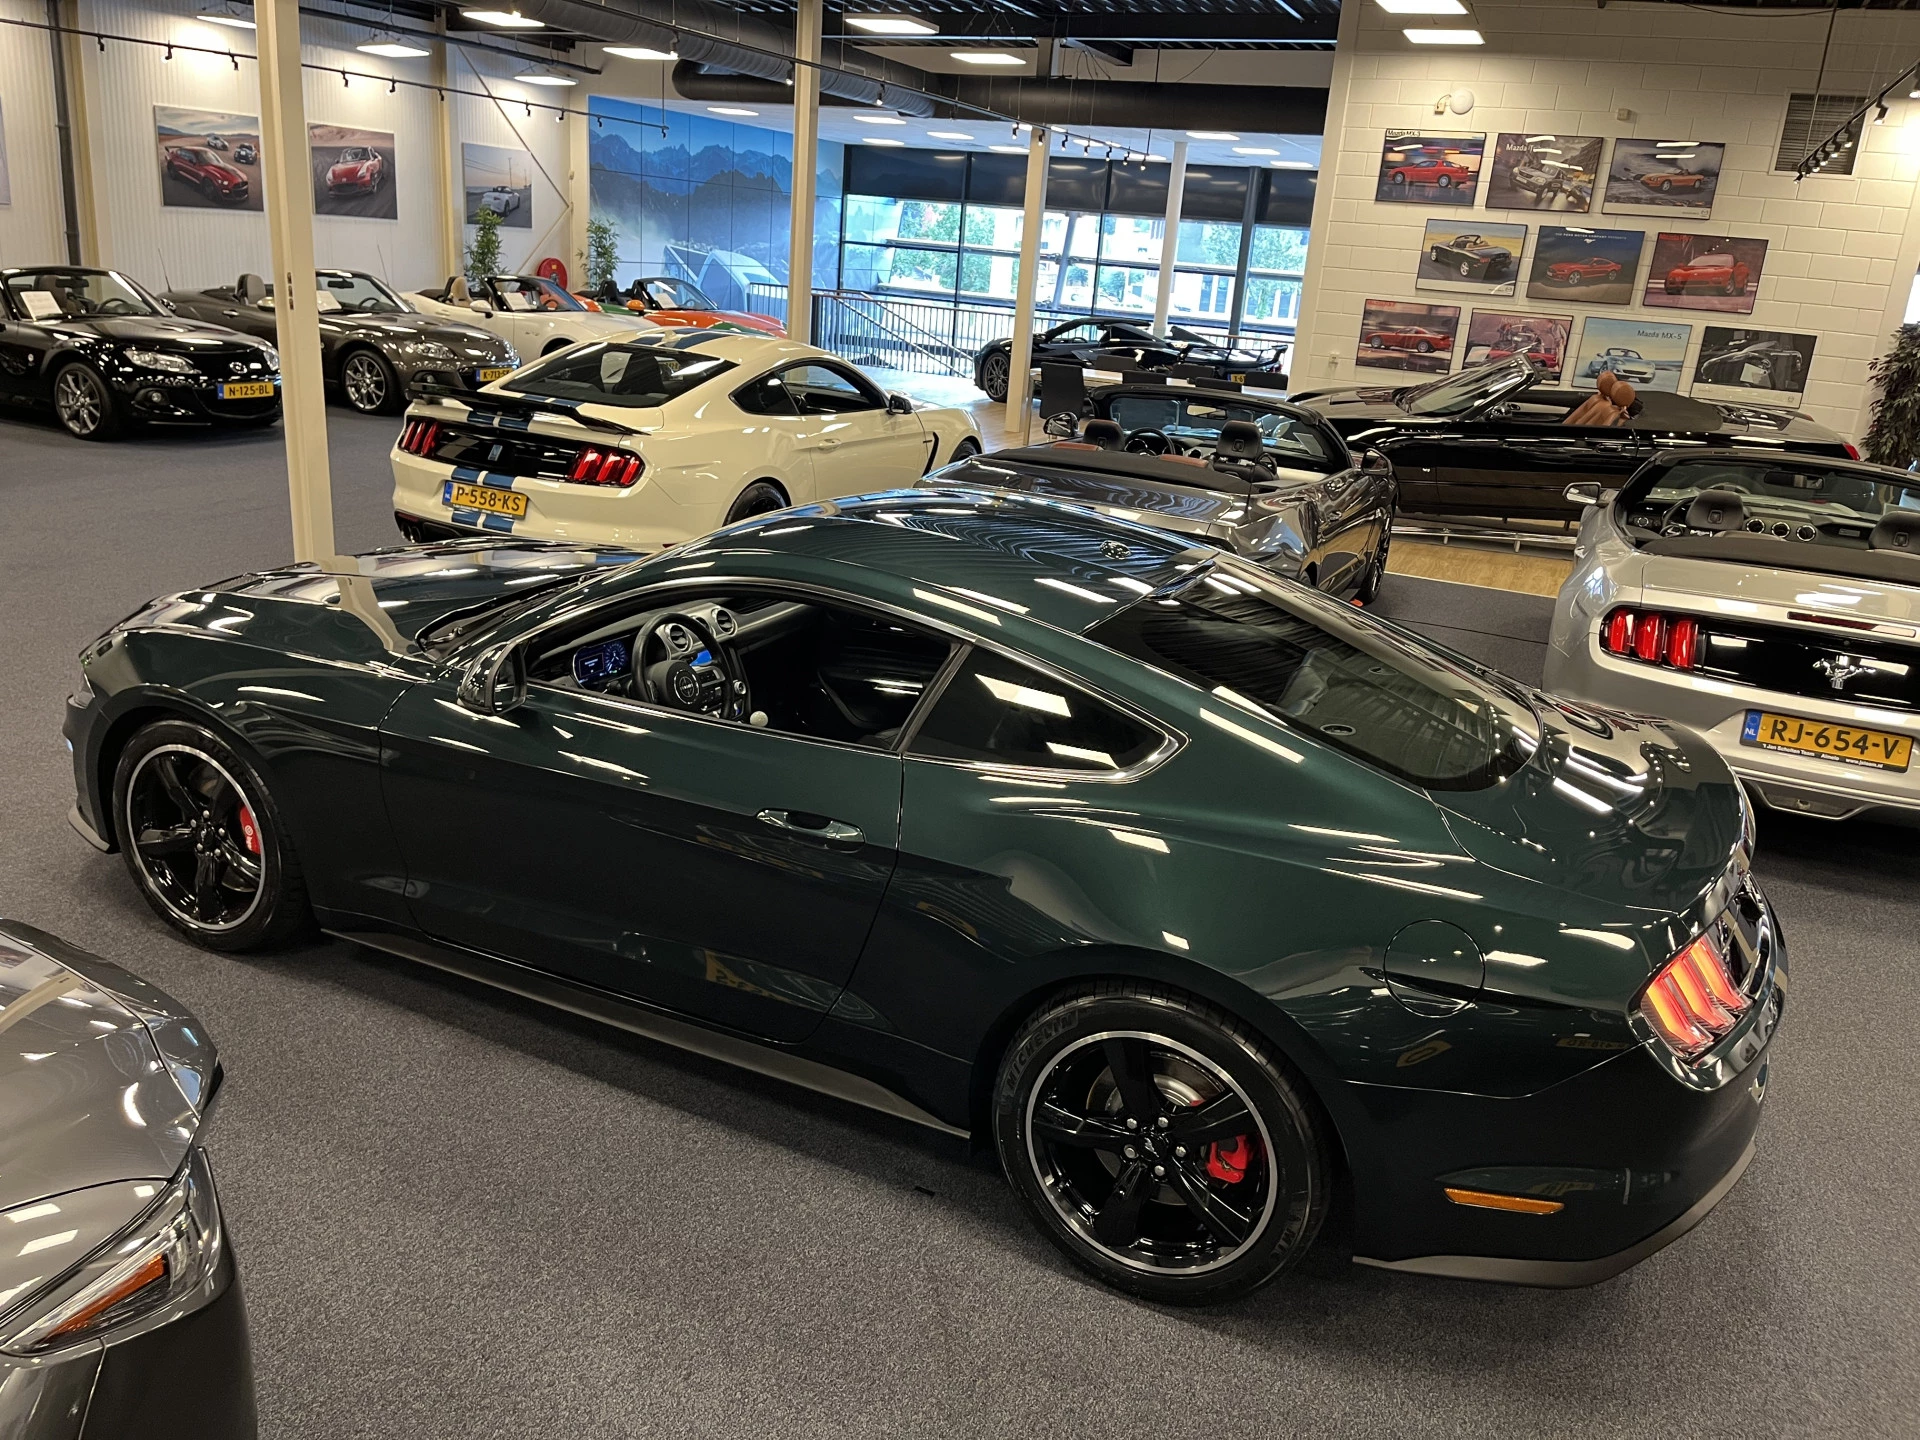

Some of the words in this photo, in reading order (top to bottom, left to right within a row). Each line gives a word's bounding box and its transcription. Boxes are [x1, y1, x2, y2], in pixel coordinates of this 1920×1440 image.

[1505, 143, 1528, 152] Mazda
[1637, 330, 1660, 338] Mazda
[1661, 331, 1683, 340] MX-5
[228, 384, 271, 397] N-125-BL
[455, 486, 522, 512] P-558-KS
[1744, 727, 1757, 736] NL
[1769, 719, 1900, 760] RJ-654-V
[1005, 1013, 1073, 1089] MICHELIN
